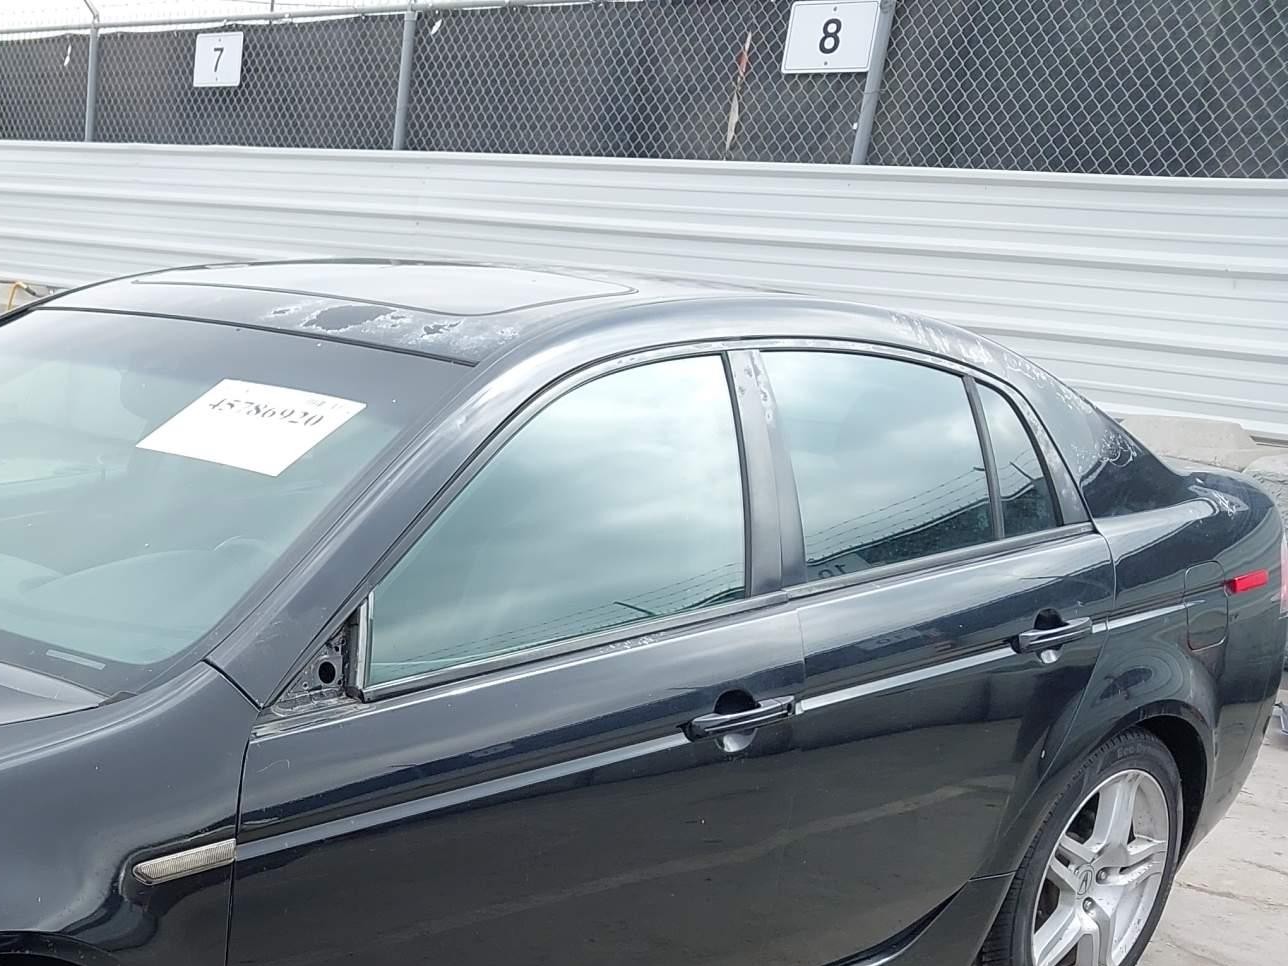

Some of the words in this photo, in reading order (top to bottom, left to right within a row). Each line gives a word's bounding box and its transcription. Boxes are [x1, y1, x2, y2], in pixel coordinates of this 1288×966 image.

[819, 18, 842, 54] 8
[213, 47, 224, 73] 7
[208, 398, 324, 426] 45786920
